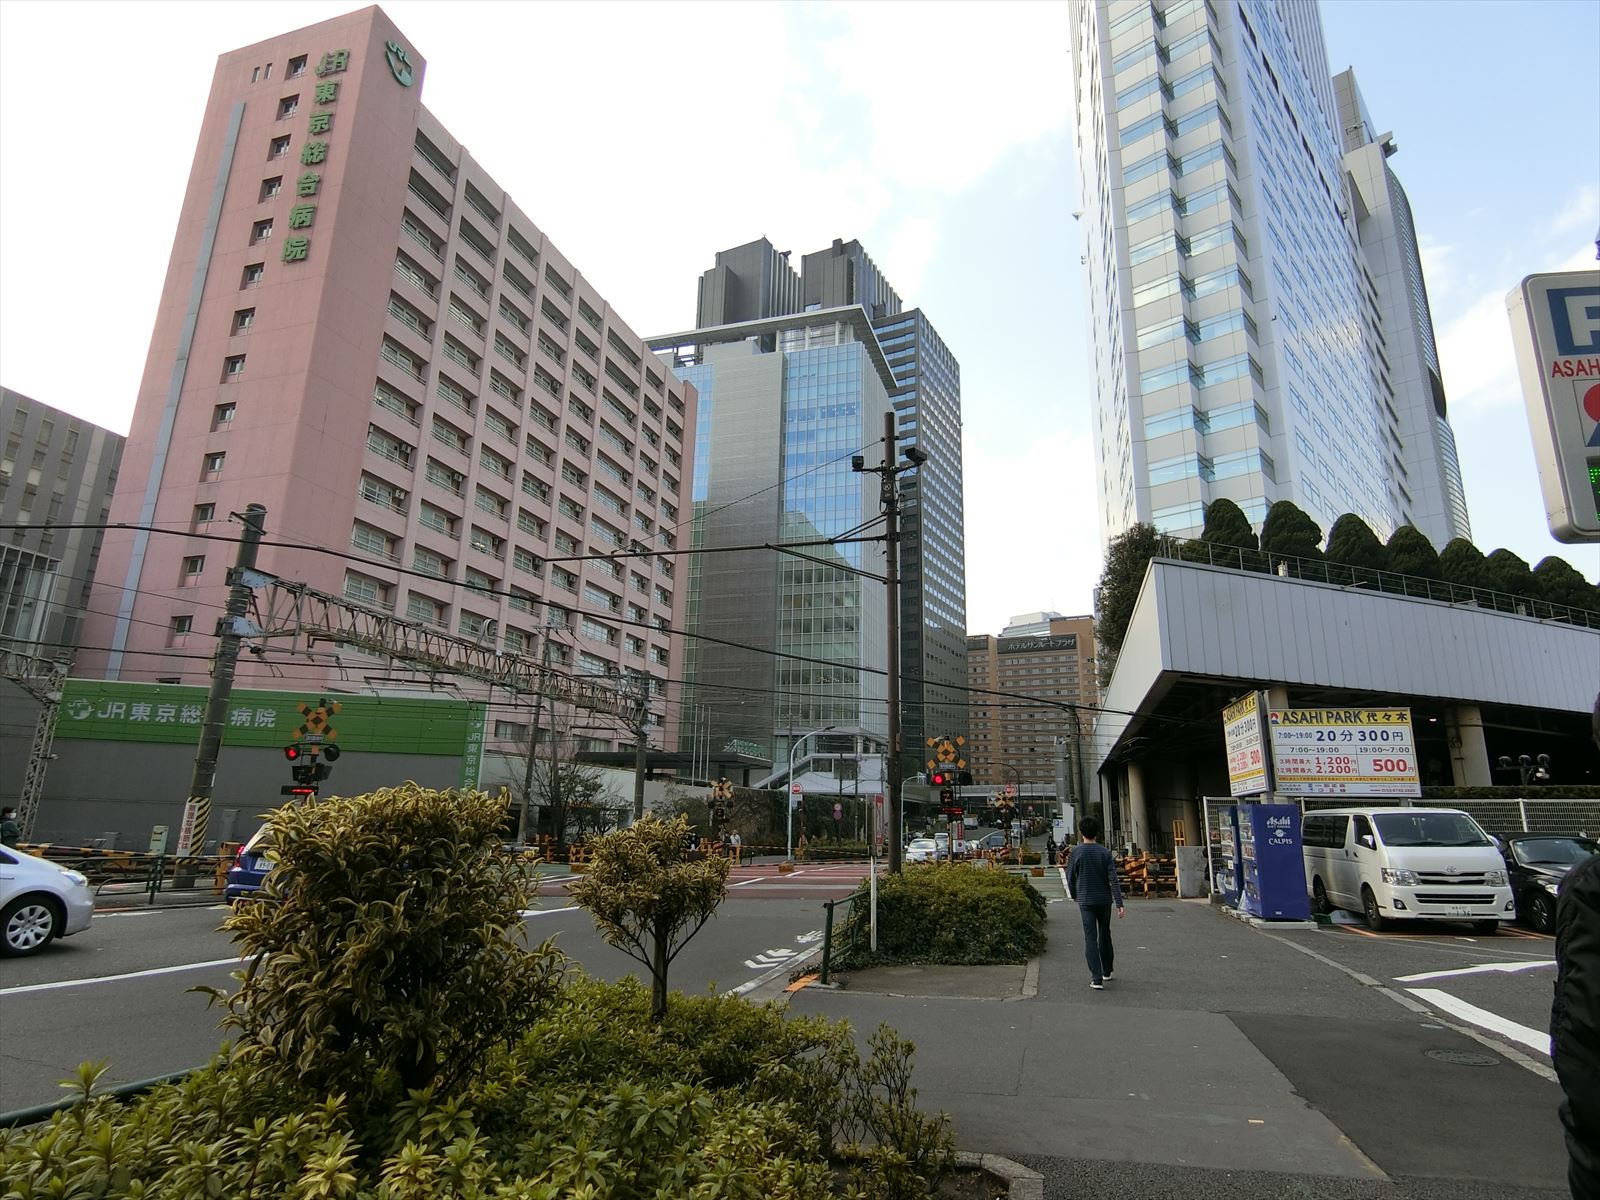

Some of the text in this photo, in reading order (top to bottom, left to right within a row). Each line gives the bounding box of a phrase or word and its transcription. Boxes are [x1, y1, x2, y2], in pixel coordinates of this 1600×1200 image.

[97, 701, 276, 728] JR東京総病院
[1282, 711, 1408, 724] ASAHI PARK 代々木
[1266, 816, 1291, 825] Asahi
[1268, 837, 1293, 846] CALPIS
